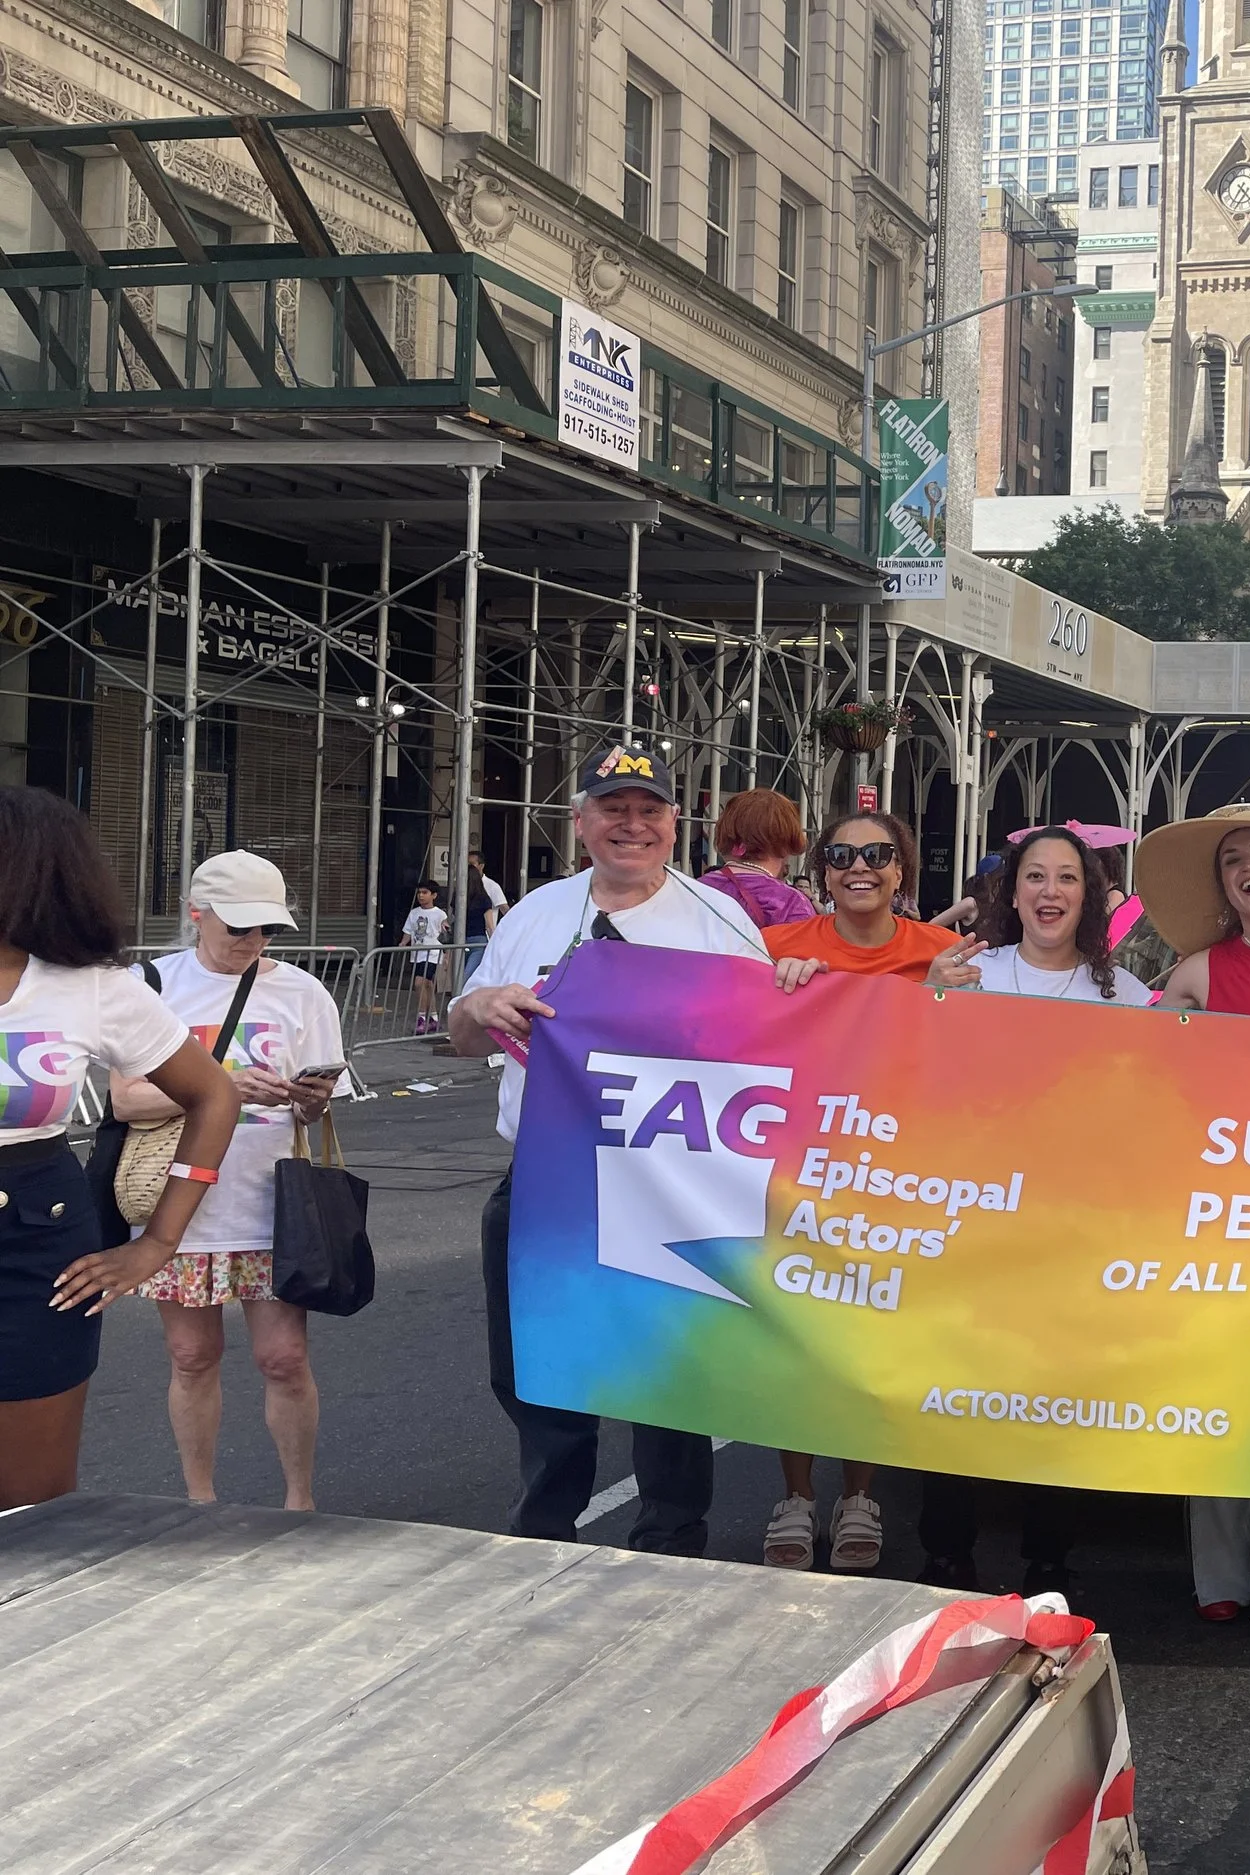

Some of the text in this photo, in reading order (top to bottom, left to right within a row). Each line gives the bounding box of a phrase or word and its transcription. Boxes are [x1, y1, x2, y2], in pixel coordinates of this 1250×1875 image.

[574, 356, 630, 388] ENTERPRISES
[574, 379, 629, 412] SIDEWALK SHED
[564, 413, 634, 456] 917-515-1257
[880, 400, 944, 465] FLATIRON
[885, 503, 936, 558] NOMAD
[906, 573, 938, 587] GFP
[1048, 600, 1087, 656] 260
[615, 754, 654, 779] M
[598, 1076, 788, 1160] EAG
[817, 1095, 899, 1143] The
[797, 1147, 1024, 1216] Episcopal
[783, 1200, 962, 1258] Actors'
[773, 1254, 903, 1311] Guild
[1102, 1260, 1161, 1292] OF
[1170, 1262, 1248, 1292] ALL
[920, 1387, 1230, 1437] ACTORSGUILD.ORG
